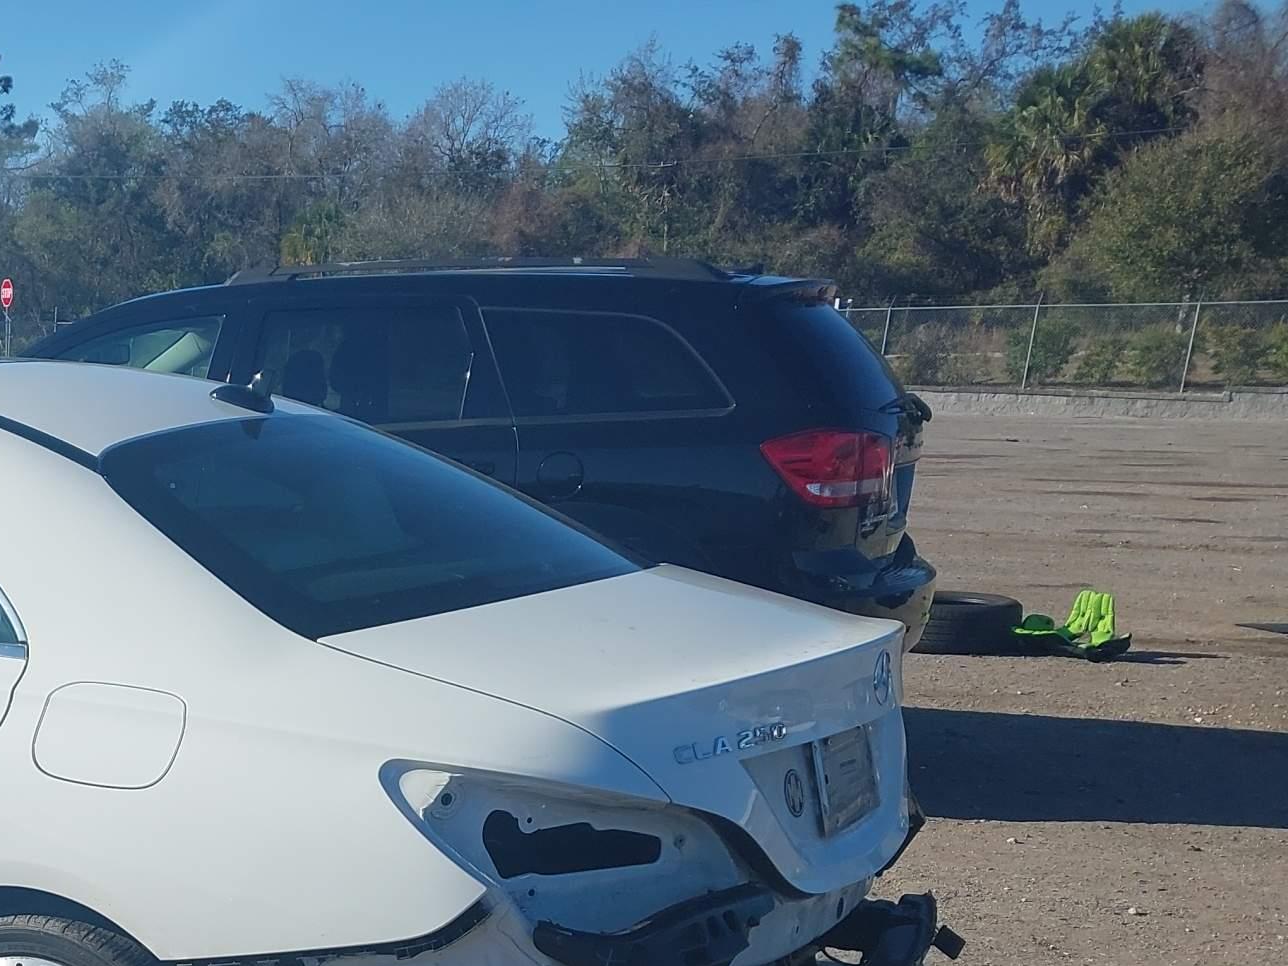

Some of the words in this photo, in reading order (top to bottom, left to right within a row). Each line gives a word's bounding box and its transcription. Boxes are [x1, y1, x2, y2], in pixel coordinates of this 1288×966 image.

[2, 288, 12, 298] STOP
[672, 735, 732, 765] CLA
[737, 722, 787, 750] 250
